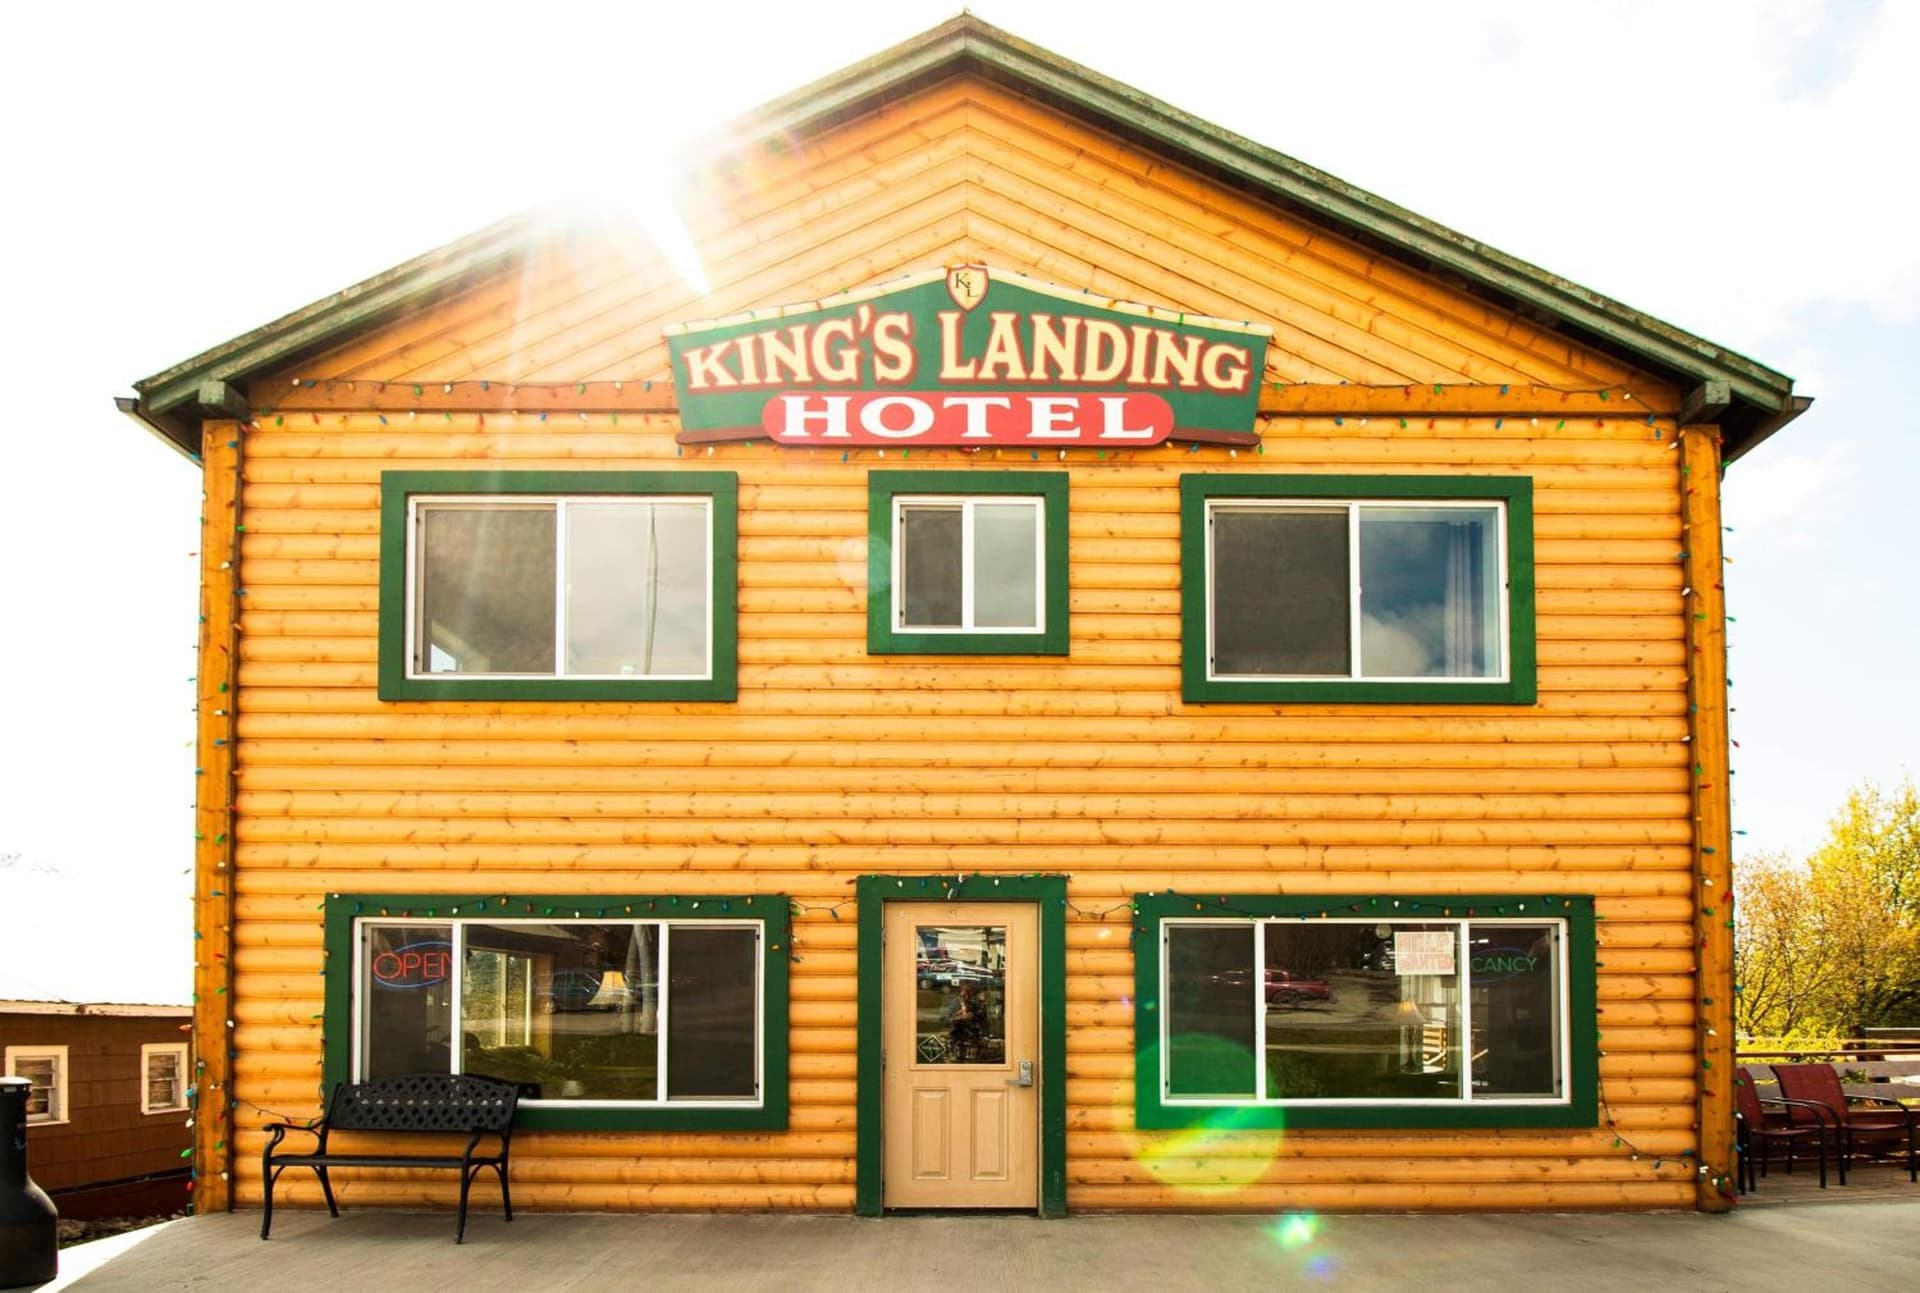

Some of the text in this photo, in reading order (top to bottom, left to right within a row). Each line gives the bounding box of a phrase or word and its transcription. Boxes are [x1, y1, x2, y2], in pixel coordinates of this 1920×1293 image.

[686, 305, 1250, 391] KING'S LANDING
[779, 396, 1154, 440] HOTEL
[1471, 956, 1537, 973] CANCY
